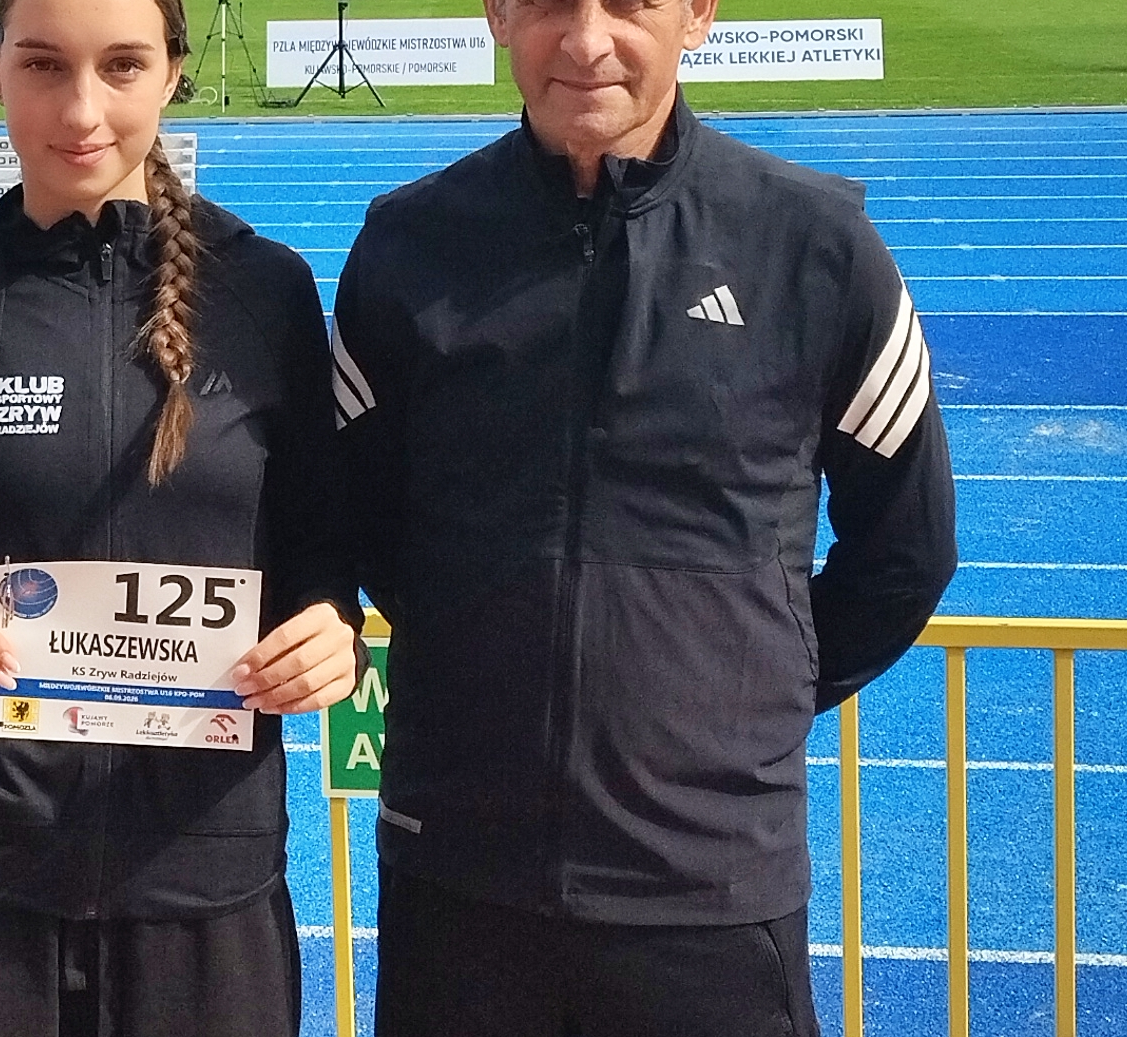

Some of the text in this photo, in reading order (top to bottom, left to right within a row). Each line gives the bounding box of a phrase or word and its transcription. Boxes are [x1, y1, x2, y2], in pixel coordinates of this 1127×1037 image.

[704, 28, 864, 44] WSKO-POMORSKI
[273, 36, 486, 54] PZLA MIĘDZYJEWÓDZKIE MISTRZOSTWA U16
[729, 50, 796, 64] LEKKIEJ
[801, 48, 881, 62] ATLETYKI
[408, 62, 457, 73] POMORSKIE
[113, 572, 238, 630] 125
[48, 630, 199, 663] ŁUKASZEWSKA
[71, 667, 178, 684] KS Zryw Radziejów
[111, 685, 159, 696] MISTRZOSTWA
